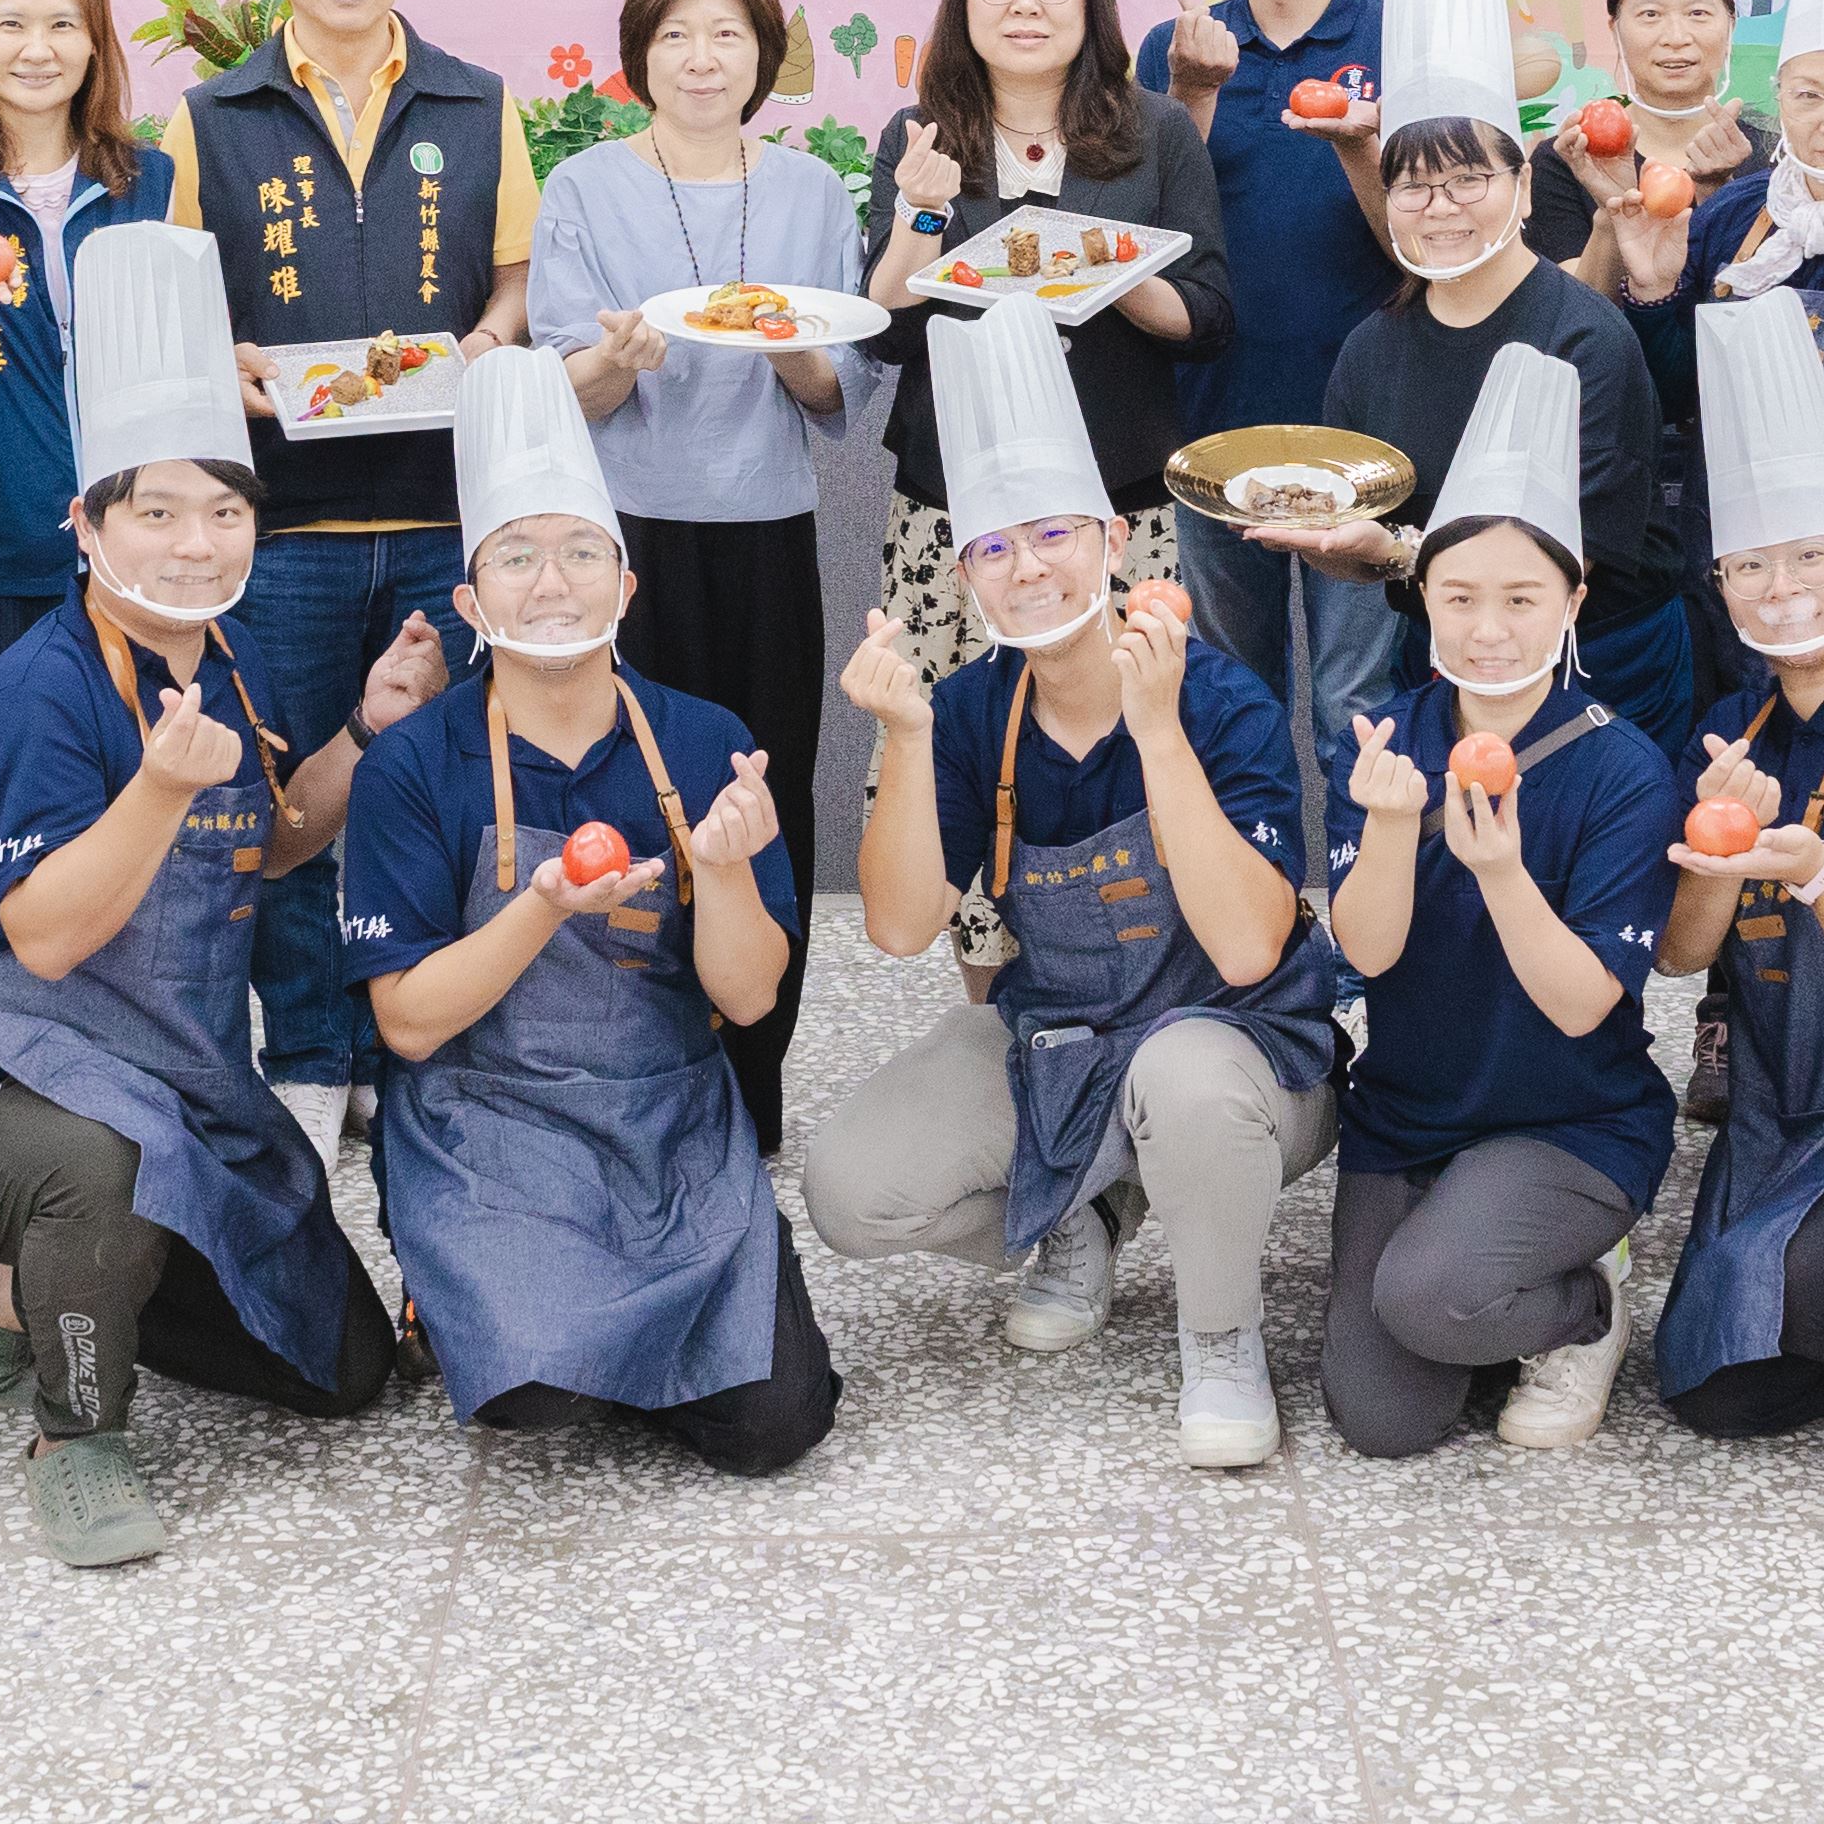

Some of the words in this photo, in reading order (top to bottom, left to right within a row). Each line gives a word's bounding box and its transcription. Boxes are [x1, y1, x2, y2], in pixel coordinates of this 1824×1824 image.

[259, 177, 303, 305] 陳耀雄
[292, 155, 321, 229] 理事長
[418, 177, 441, 304] 新竹縣農會
